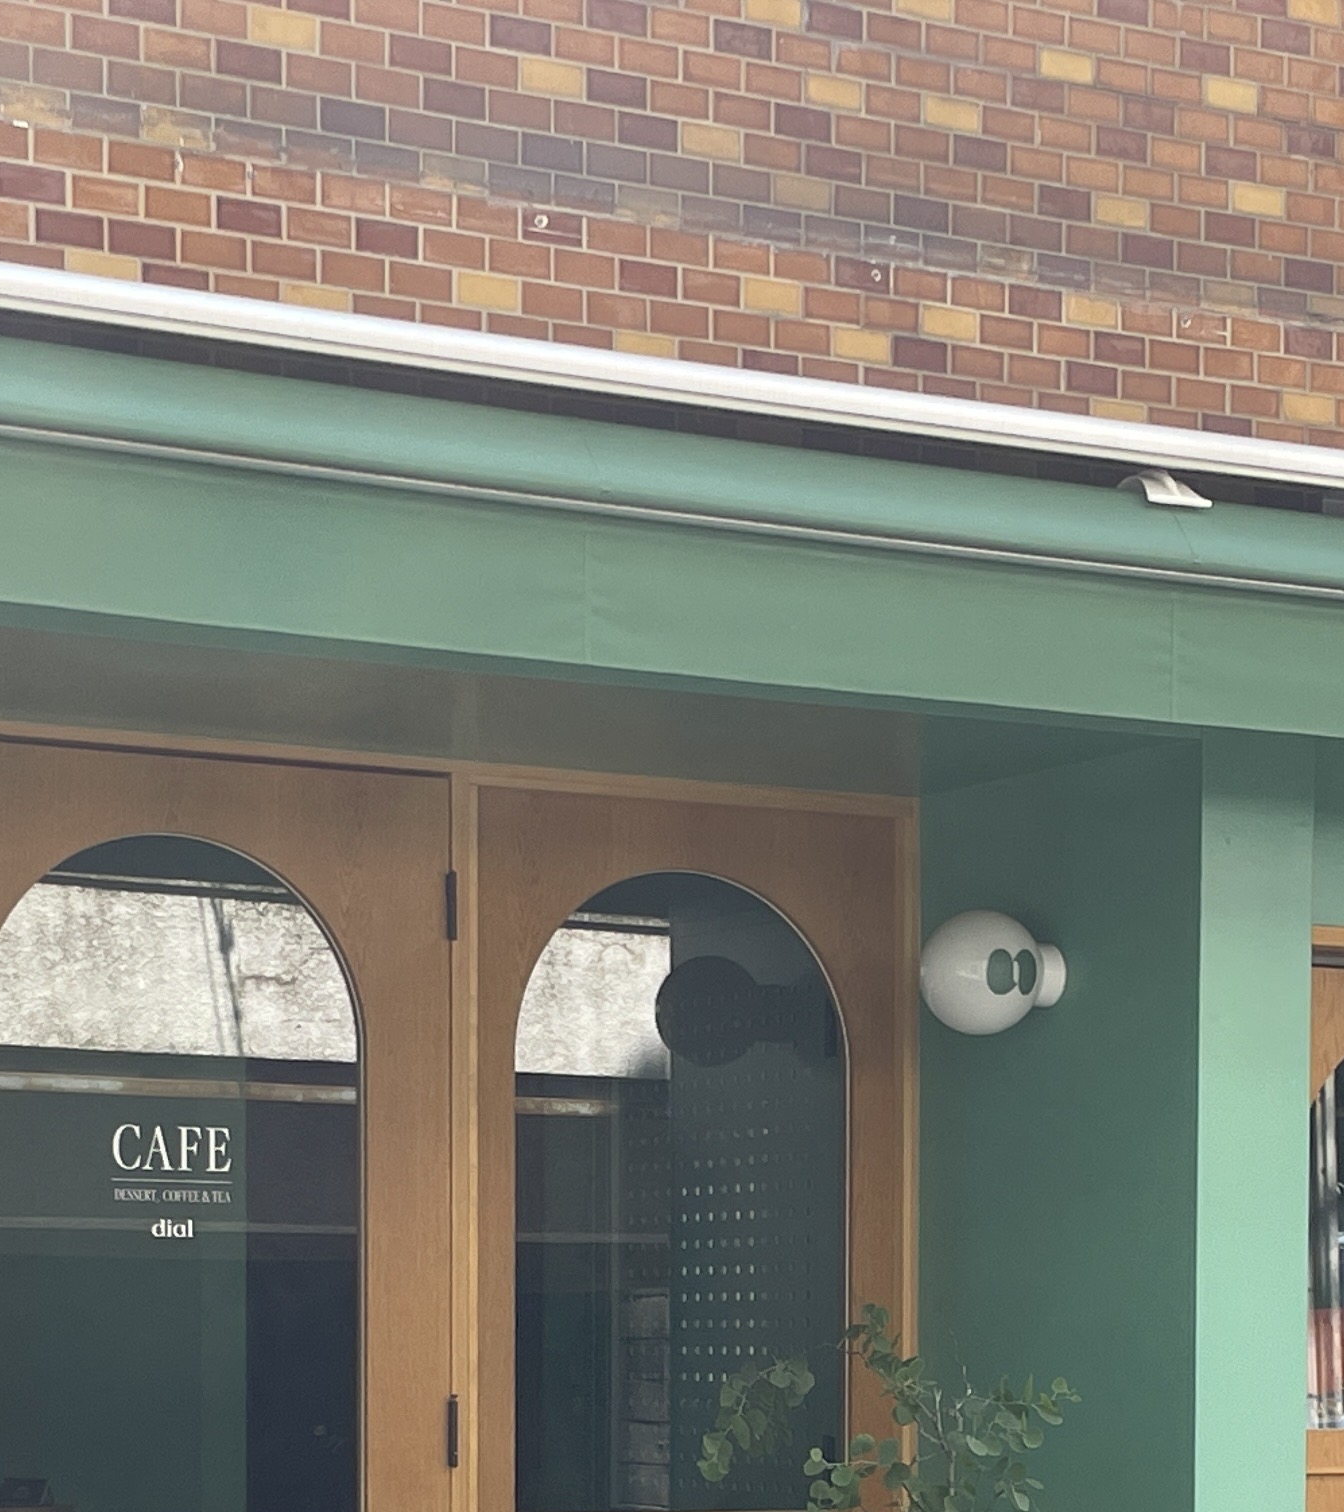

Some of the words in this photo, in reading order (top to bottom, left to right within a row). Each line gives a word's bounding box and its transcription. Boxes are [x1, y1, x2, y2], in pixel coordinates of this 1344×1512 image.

[112, 1123, 233, 1173] CAFE
[162, 1189, 200, 1203] COFFEE
[212, 1190, 232, 1203] TEA
[151, 1219, 194, 1238] dial
